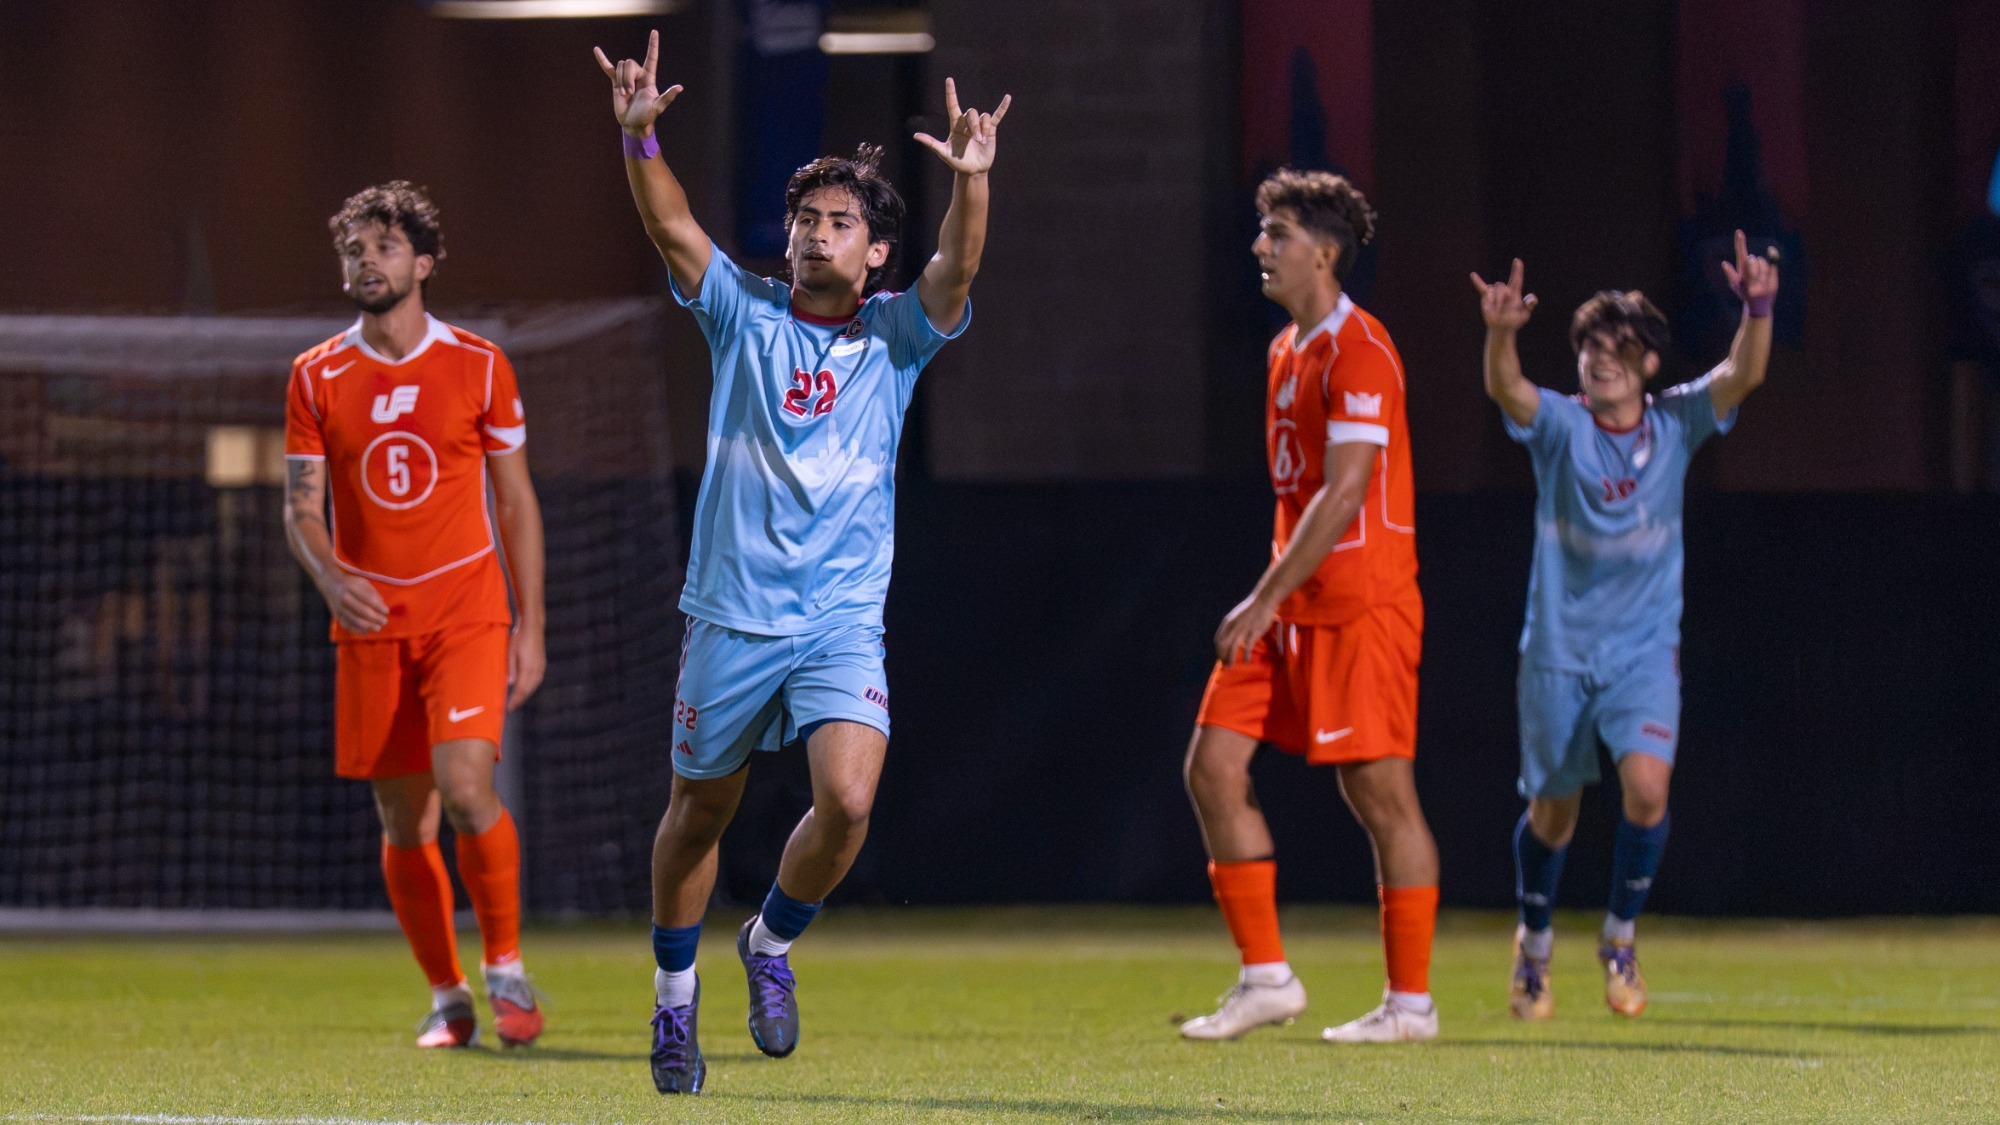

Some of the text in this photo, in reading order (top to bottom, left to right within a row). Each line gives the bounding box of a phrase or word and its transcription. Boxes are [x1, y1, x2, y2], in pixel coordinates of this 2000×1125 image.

[370, 385, 420, 424] UF
[782, 366, 837, 419] 22
[387, 445, 410, 496] 5
[1274, 432, 1292, 480] 6
[677, 699, 698, 731] 22
